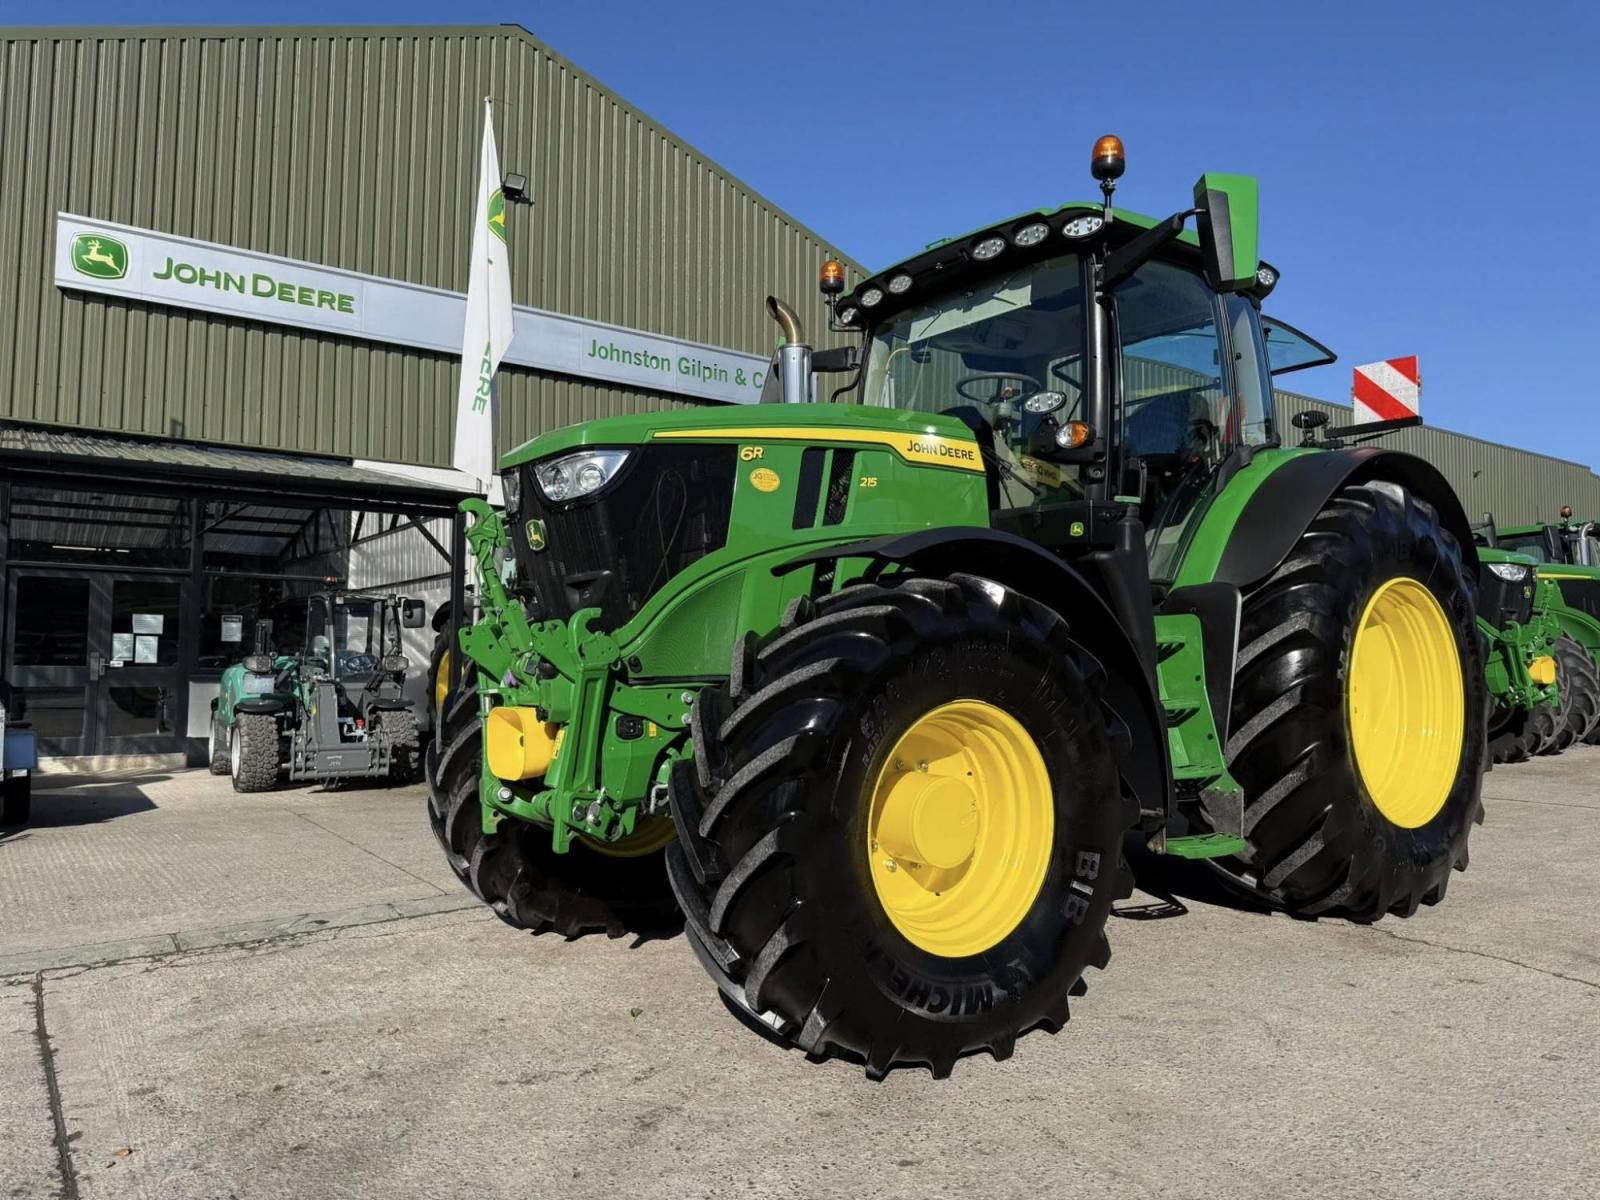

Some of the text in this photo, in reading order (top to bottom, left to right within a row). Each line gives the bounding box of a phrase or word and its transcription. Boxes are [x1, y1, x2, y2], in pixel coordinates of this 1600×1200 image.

[153, 256, 354, 314] JOHN DEERE
[587, 339, 671, 372] Johnston
[678, 356, 728, 382] Gilpin
[735, 368, 747, 386] &
[740, 446, 764, 461] 6R
[907, 440, 975, 461] JOHN DEERE
[860, 477, 878, 487] 215
[1064, 850, 1101, 926] BIB
